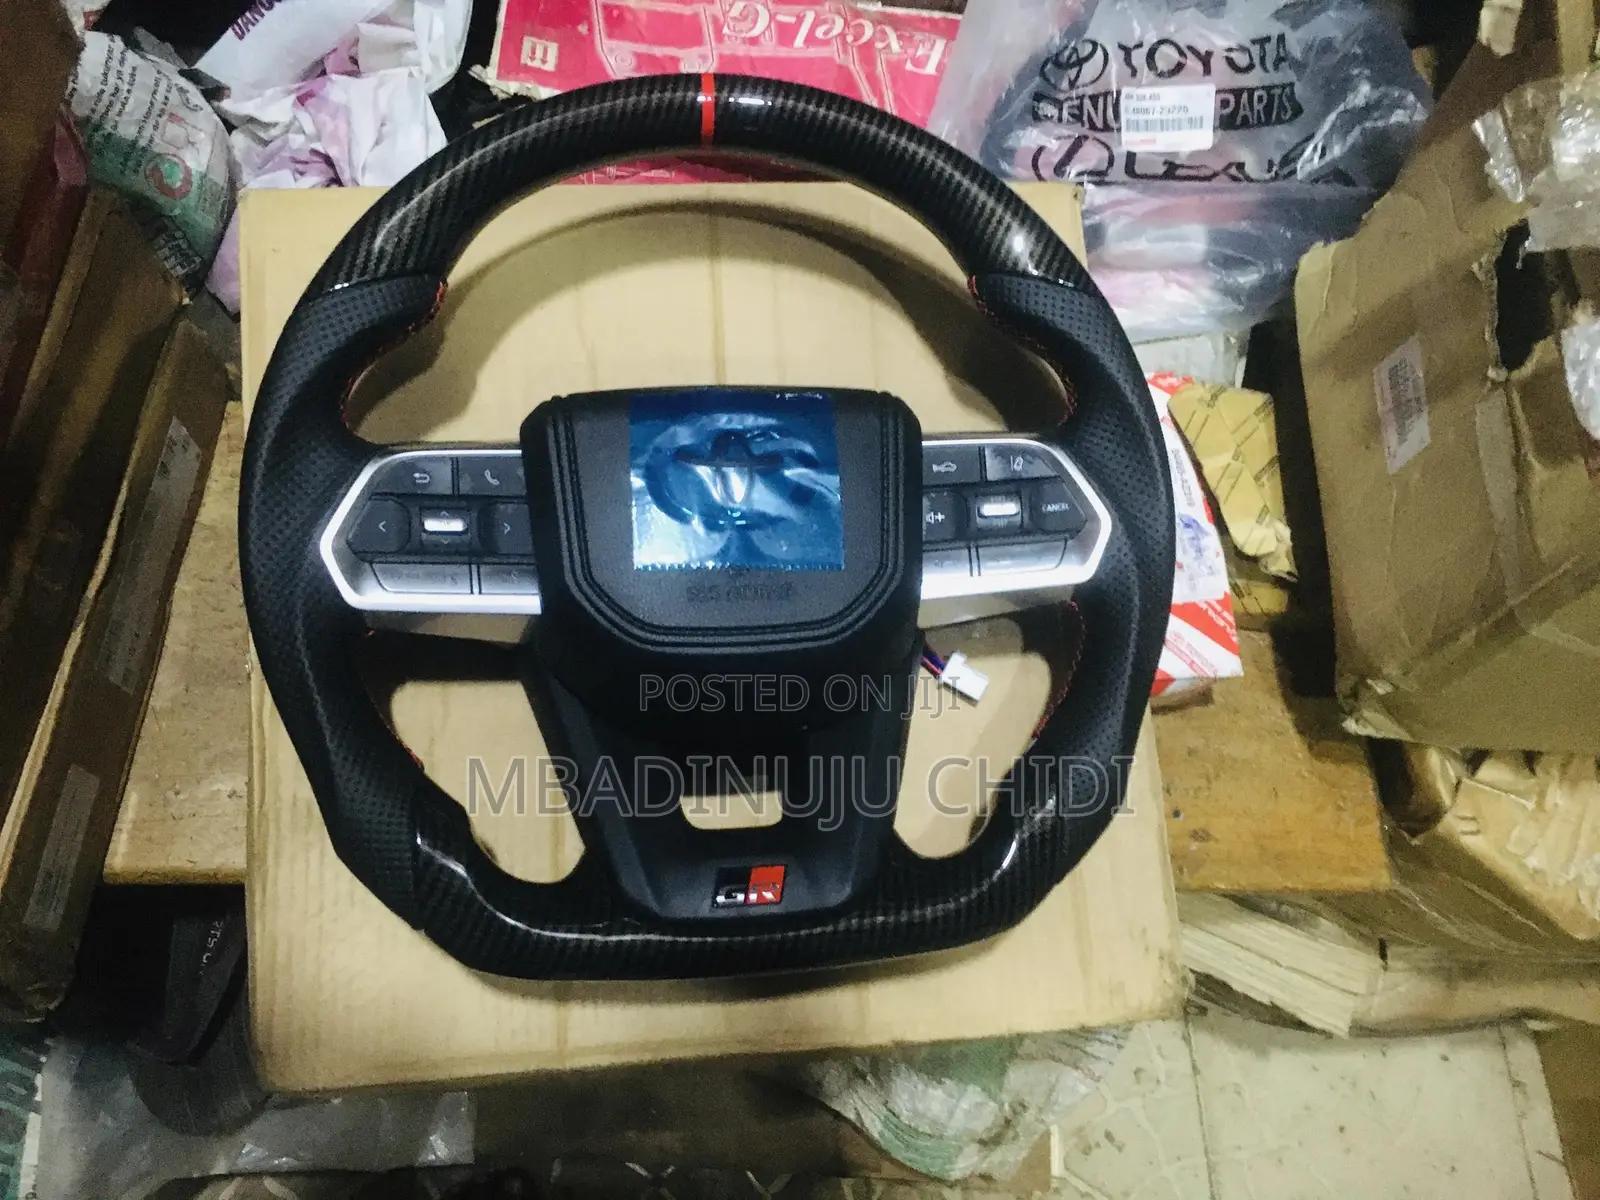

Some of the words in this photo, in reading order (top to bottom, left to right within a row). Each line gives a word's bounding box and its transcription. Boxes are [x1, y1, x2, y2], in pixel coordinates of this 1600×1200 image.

[722, 1, 947, 76] Excel-G
[1117, 33, 1290, 78] TOYOTA
[1214, 86, 1293, 126] PARTS
